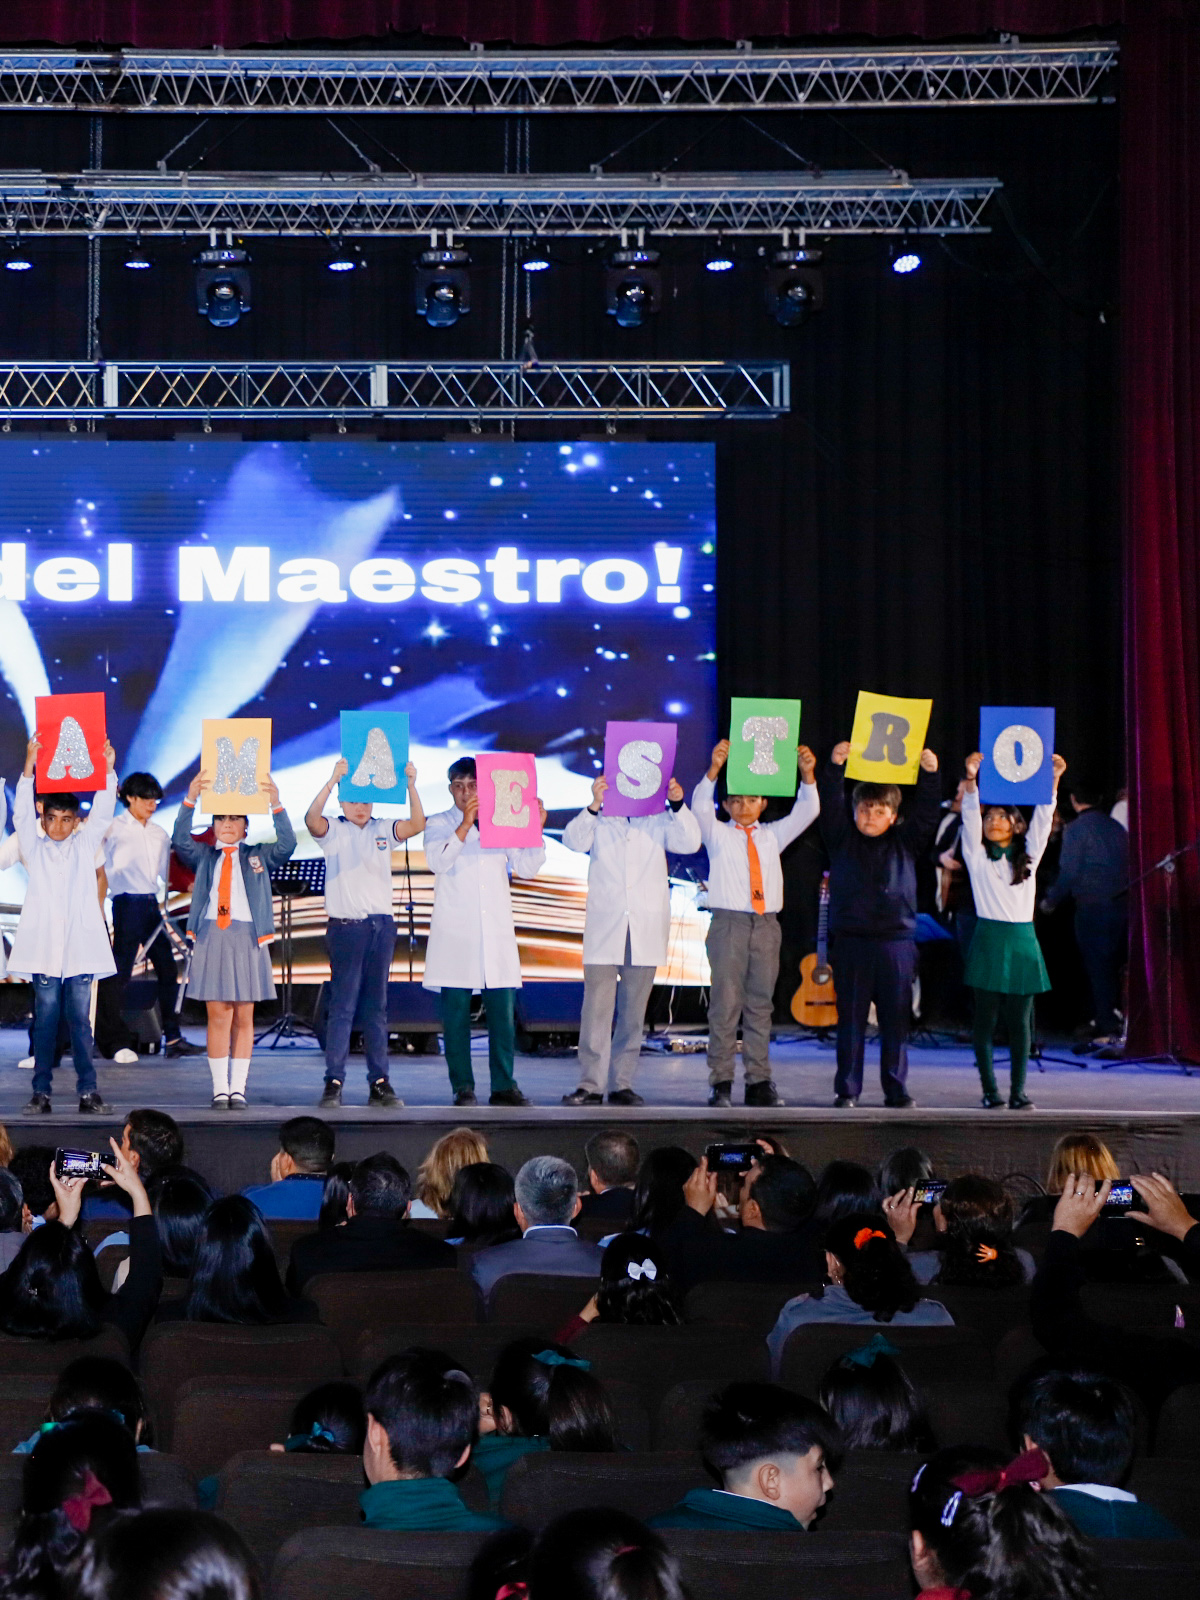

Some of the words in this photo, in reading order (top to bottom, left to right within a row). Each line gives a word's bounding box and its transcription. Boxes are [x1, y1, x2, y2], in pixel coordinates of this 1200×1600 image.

[178, 546, 683, 604] Maestro!
[46, 716, 94, 780] A
[212, 737, 260, 796] M
[351, 727, 397, 790] A
[742, 716, 788, 776] T
[862, 712, 909, 766] R
[993, 724, 1045, 783] O
[491, 769, 531, 829] E
[616, 740, 662, 800] S
